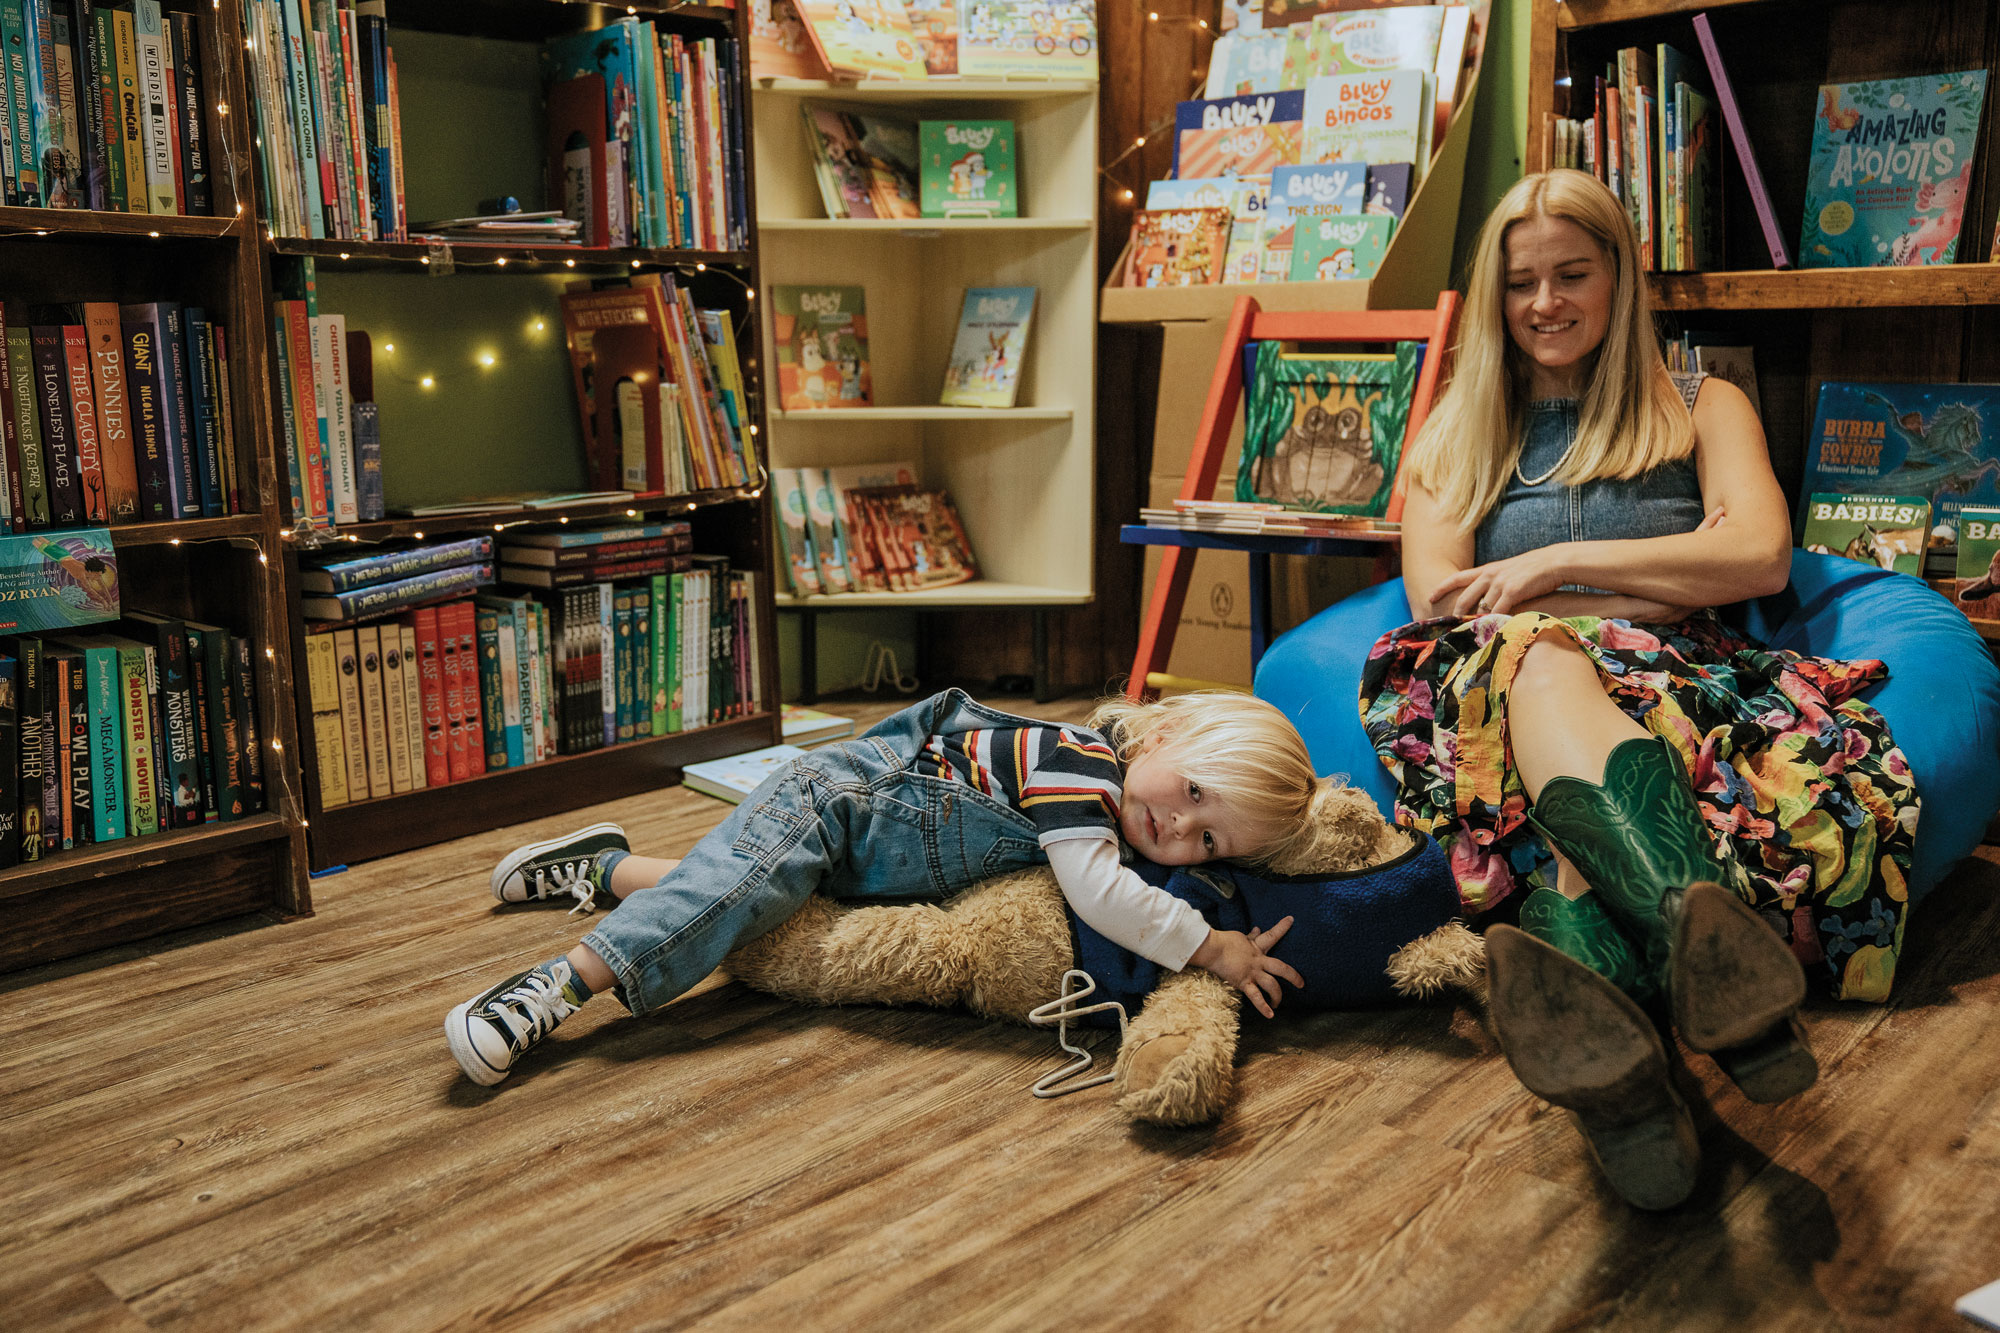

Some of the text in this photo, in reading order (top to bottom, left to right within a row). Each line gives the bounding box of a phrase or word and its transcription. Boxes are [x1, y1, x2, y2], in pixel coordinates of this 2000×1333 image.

[88, 36, 99, 74] PRINCESS
[97, 17, 108, 67] GEORGE LOPEZ
[120, 20, 128, 45] GEORGE
[40, 44, 57, 95] GRIEVES
[58, 71, 75, 110] SWIFTS
[347, 82, 355, 95] BIG
[11, 53, 33, 165] NOT ANOTHER BANNED BOOK
[91, 74, 103, 120] PROTECTION
[146, 47, 160, 101] WORDS
[154, 118, 167, 170] APART
[296, 70, 306, 105] KAWAII
[301, 108, 313, 159] COLORING
[92, 121, 106, 158] PROGRAM
[1845, 107, 1947, 147] AMAZING
[191, 152, 201, 169] PIZZA
[1829, 137, 1955, 188] AXOLOTLS
[1288, 203, 1343, 216] THE SIGN
[66, 338, 86, 346] SENF
[97, 349, 126, 440] PENNIES
[132, 333, 158, 459] GIANT NICOLA SKINNER
[176, 381, 184, 395] THE
[294, 313, 318, 449] MY FIRST ENCYCLOPEDIA
[16, 373, 41, 487] NIGHTHOUSE KEEPER
[44, 373, 70, 488] LONELIEST PLACE
[72, 363, 101, 472] THE CLACKITY
[205, 421, 213, 434] THE
[278, 358, 297, 464] Illustrated Dictionary
[329, 324, 350, 493] CHILDREN'S VISUAL DICTIONARY
[1823, 419, 1887, 439] BUBBA
[180, 437, 189, 453] AND
[208, 448, 217, 485] BEGINNING
[1820, 442, 1884, 458] COWBOY
[183, 455, 194, 501] EVERYTHING
[1842, 496, 1896, 504] PRONGHORN
[1815, 503, 1921, 526] BABIES!
[19, 586, 61, 600] RYAN
[32, 577, 56, 585] ECHO
[37, 568, 60, 576] Author
[20, 648, 42, 779] TREMBLAY ANOTHER
[181, 689, 196, 760] WHERE THERE BE
[520, 663, 533, 735] PAPERCLIP
[72, 669, 90, 809] TUBB FOWL PLAY
[130, 678, 150, 803] MONSTER MOVIE!
[166, 690, 187, 762] MONSTERS
[346, 687, 364, 779] THE ONE AND ONLY FAMILY
[369, 684, 386, 775] THE ONE AND ONLY FAMILY
[391, 680, 407, 771] THE ONE AND ONLY FAMILY
[43, 711, 57, 816] THE LABYRINTH OF SOULS
[99, 716, 116, 814] MEGAMONSTER
[328, 737, 344, 791] Underneath
